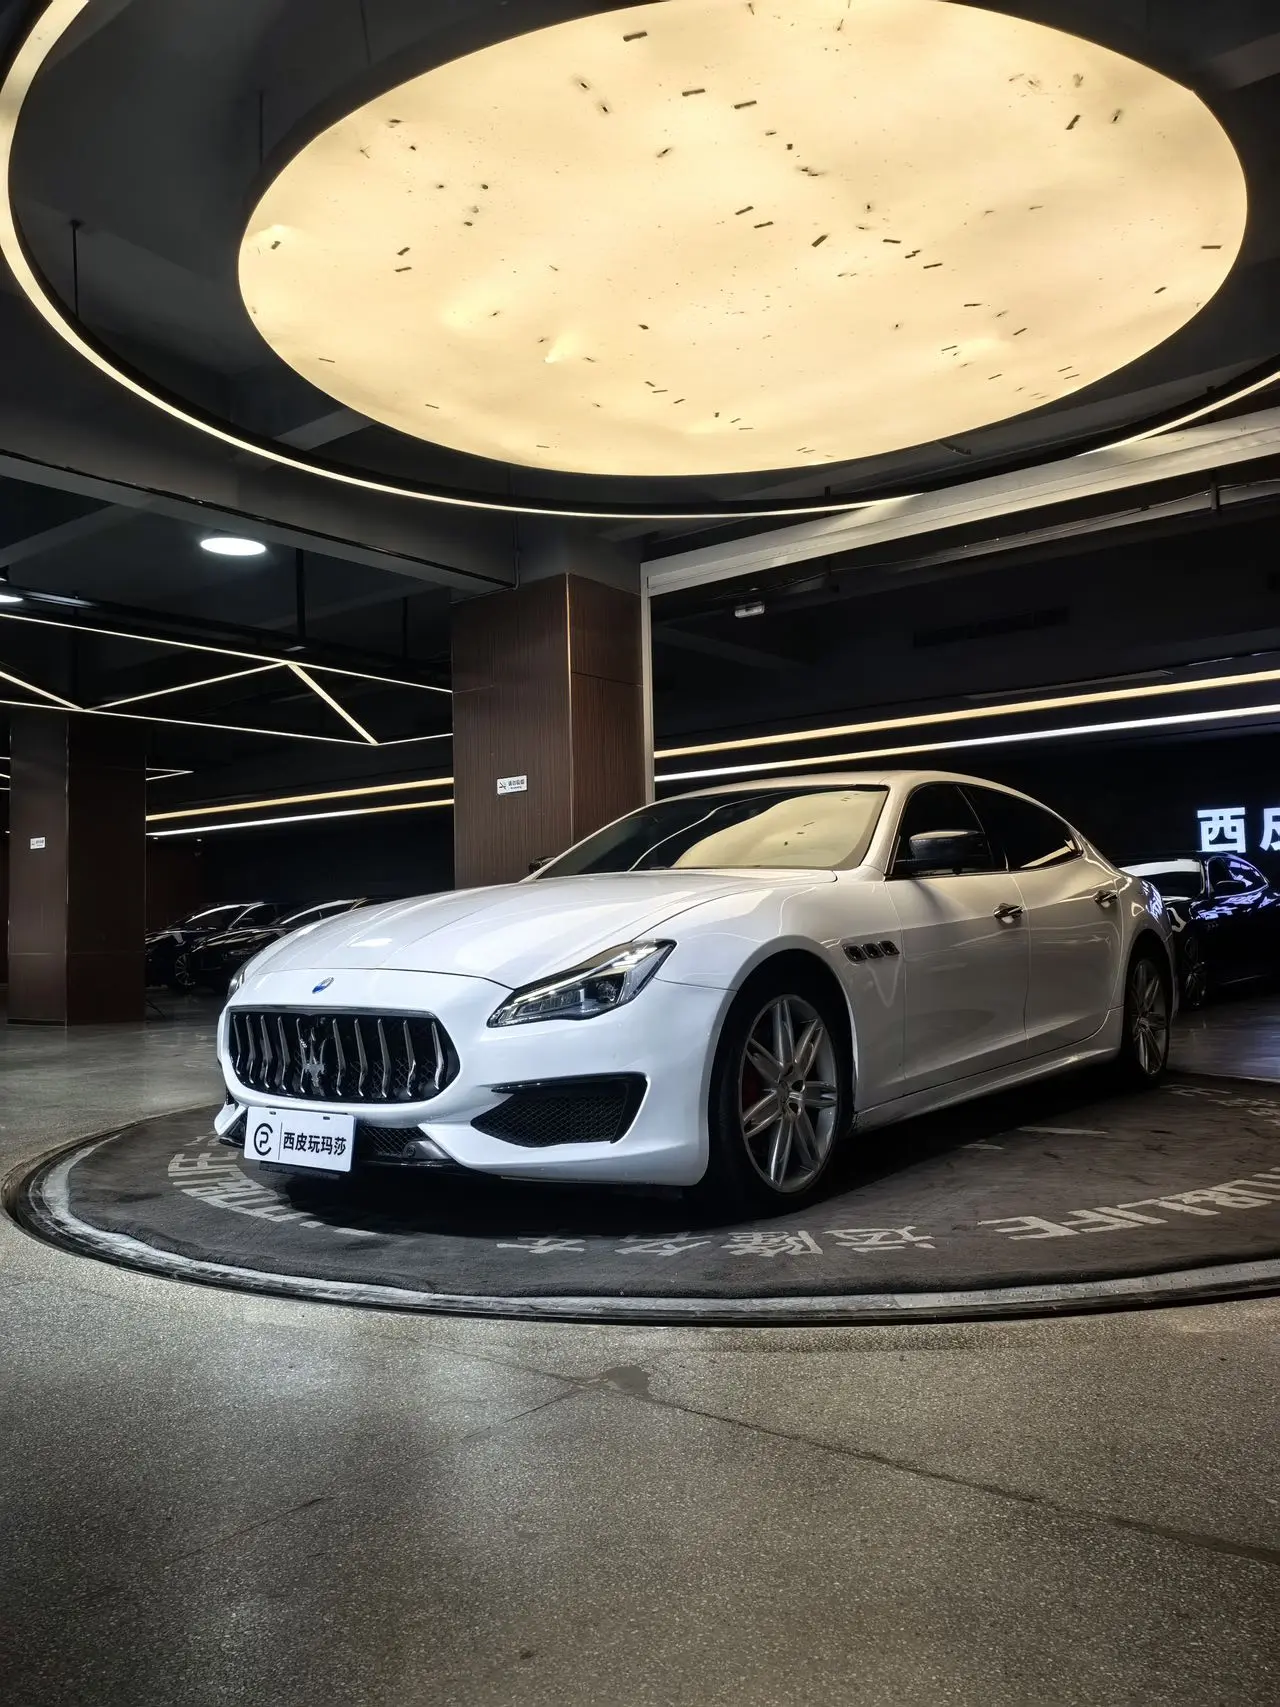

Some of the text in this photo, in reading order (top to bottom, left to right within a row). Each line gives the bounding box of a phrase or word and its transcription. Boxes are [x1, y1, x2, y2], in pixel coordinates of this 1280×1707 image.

[283, 1131, 347, 1156] 西皮玩玛莎
